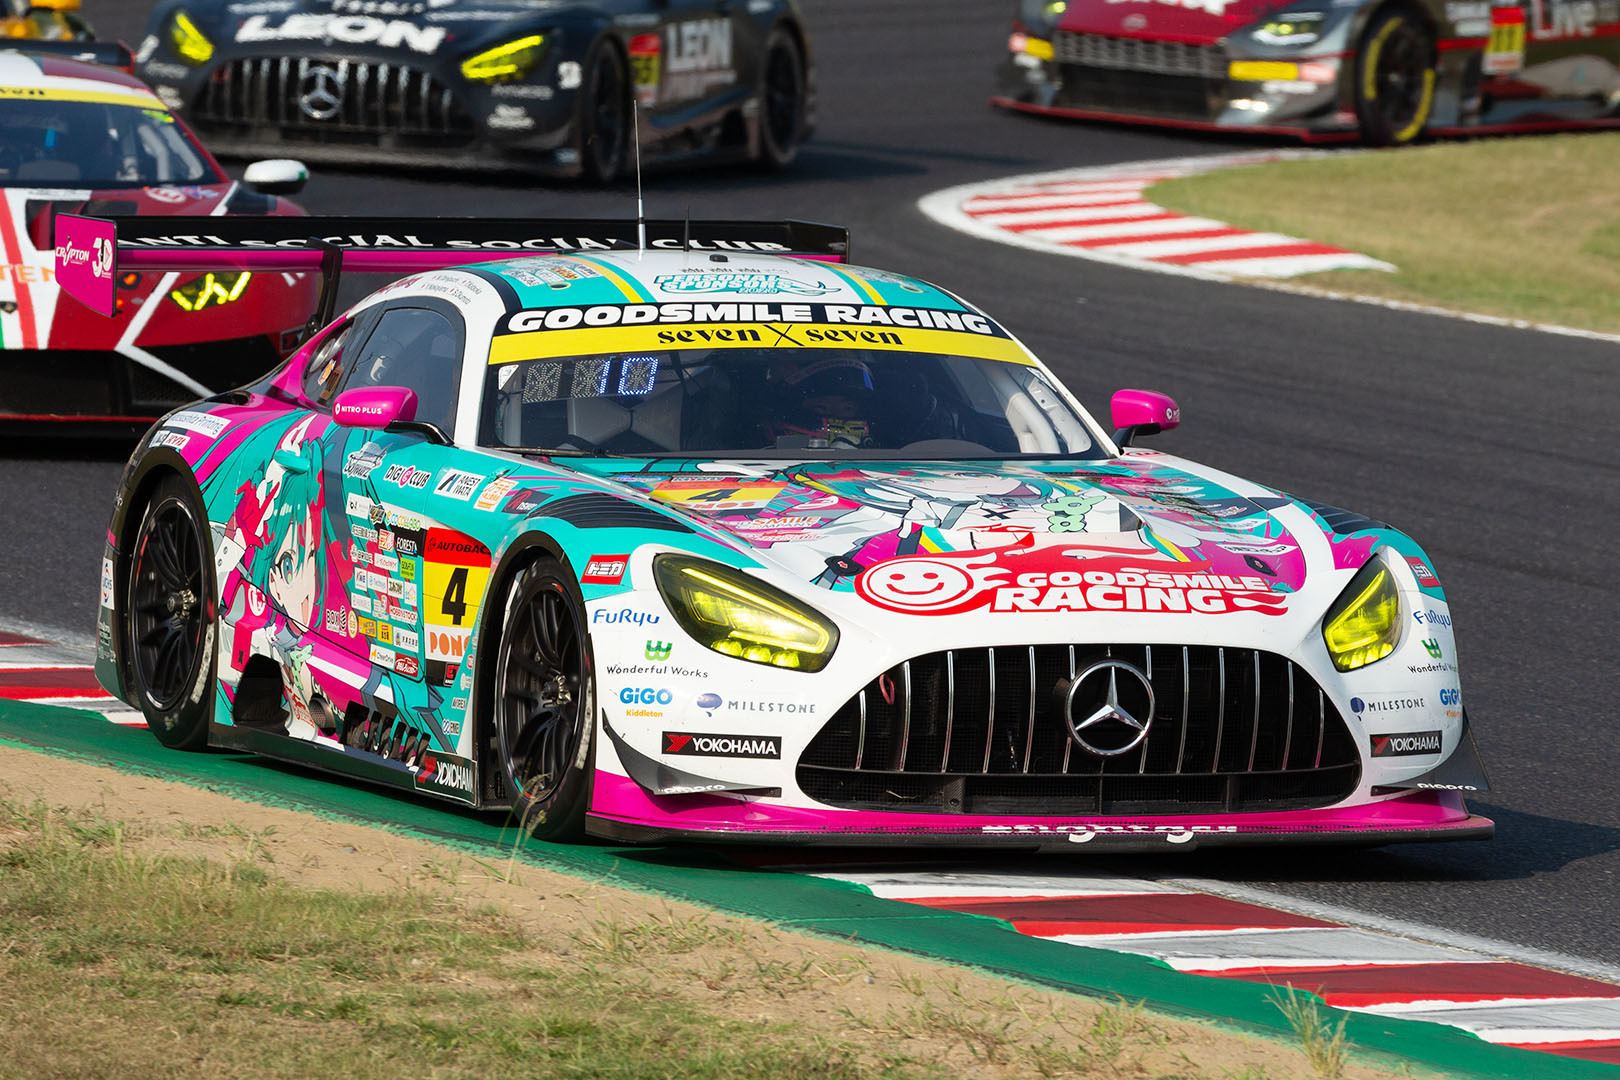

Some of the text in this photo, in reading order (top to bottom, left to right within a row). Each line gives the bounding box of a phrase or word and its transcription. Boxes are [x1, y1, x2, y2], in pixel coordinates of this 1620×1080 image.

[235, 13, 446, 54] LEON
[446, 237, 618, 250] SOCIA
[652, 238, 793, 251] CLUB
[827, 305, 994, 335] RACING
[657, 326, 762, 346] seven
[805, 328, 904, 346] seven
[341, 405, 382, 415] NITRO PLUS
[686, 488, 742, 502] 4
[436, 541, 491, 555] AUTOBAC
[442, 567, 469, 626] 4
[994, 586, 1226, 612] RACING
[593, 608, 660, 627] FuRyu
[1412, 609, 1451, 629] FuRyu
[606, 663, 709, 678] Wonderful Works
[1407, 662, 1448, 674] Wonderful
[620, 687, 673, 705] GiGO
[1368, 697, 1425, 712] MILESTONE
[626, 708, 663, 718] Kiddleton
[727, 700, 816, 714] MILESTONE
[692, 736, 778, 755] YOKOHAMA
[1389, 735, 1440, 752] YOKOHAMA
